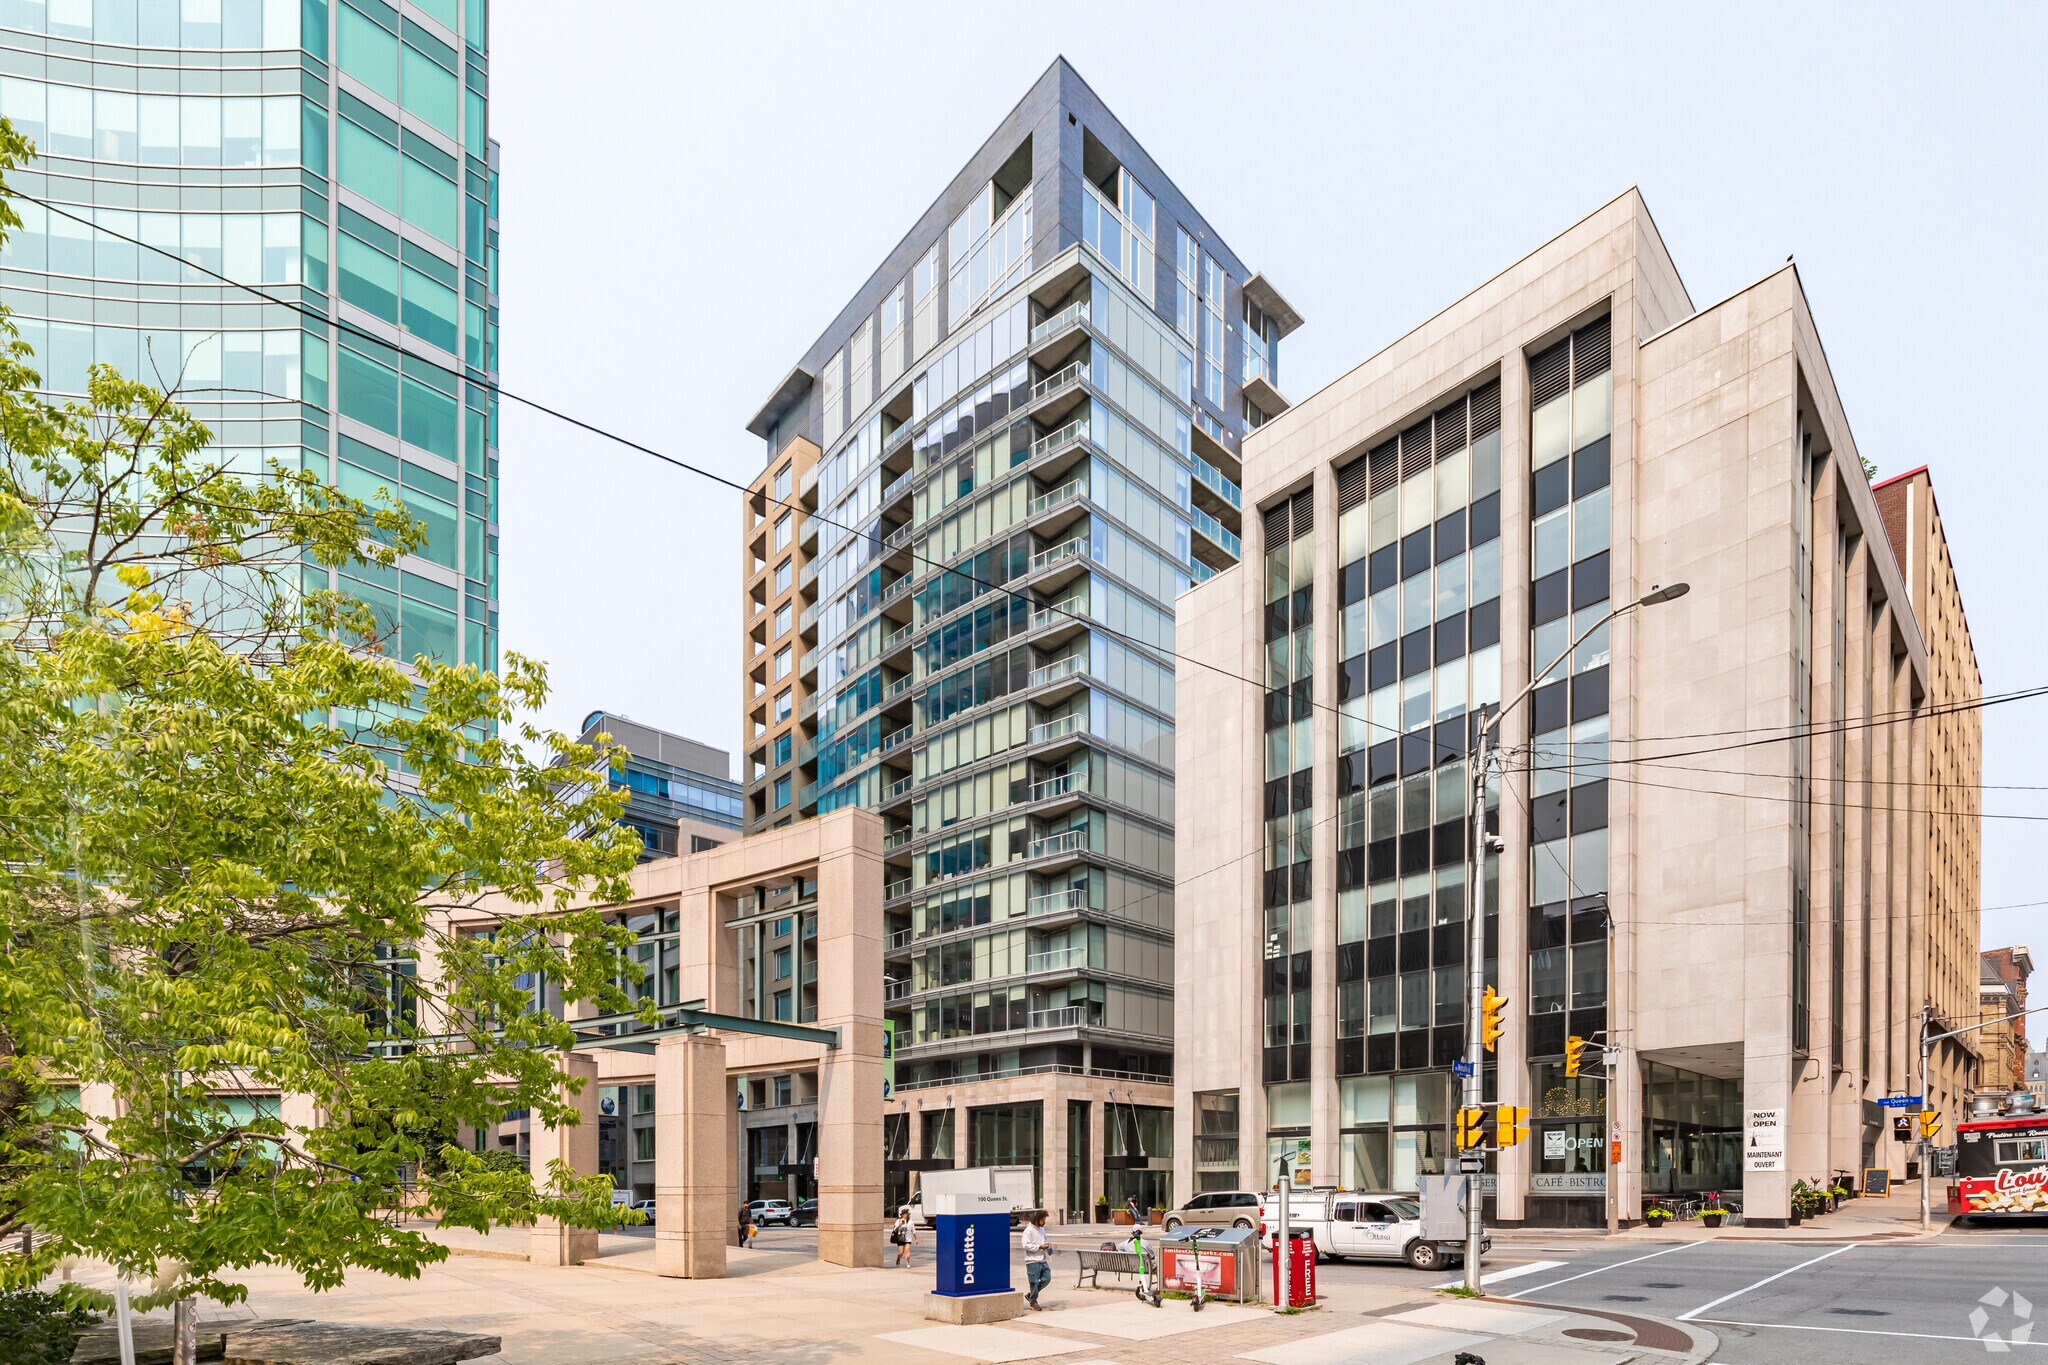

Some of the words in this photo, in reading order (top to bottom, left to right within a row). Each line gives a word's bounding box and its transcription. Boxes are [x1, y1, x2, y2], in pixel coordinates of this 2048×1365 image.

[1565, 1136, 1604, 1151] OPEN
[1536, 1176, 1563, 1187] CAFÉ
[1569, 1177, 1606, 1187] BISTRO
[1163, 1248, 1234, 1257] SmilesOnparks.com
[1304, 1259, 1312, 1296] FREE
